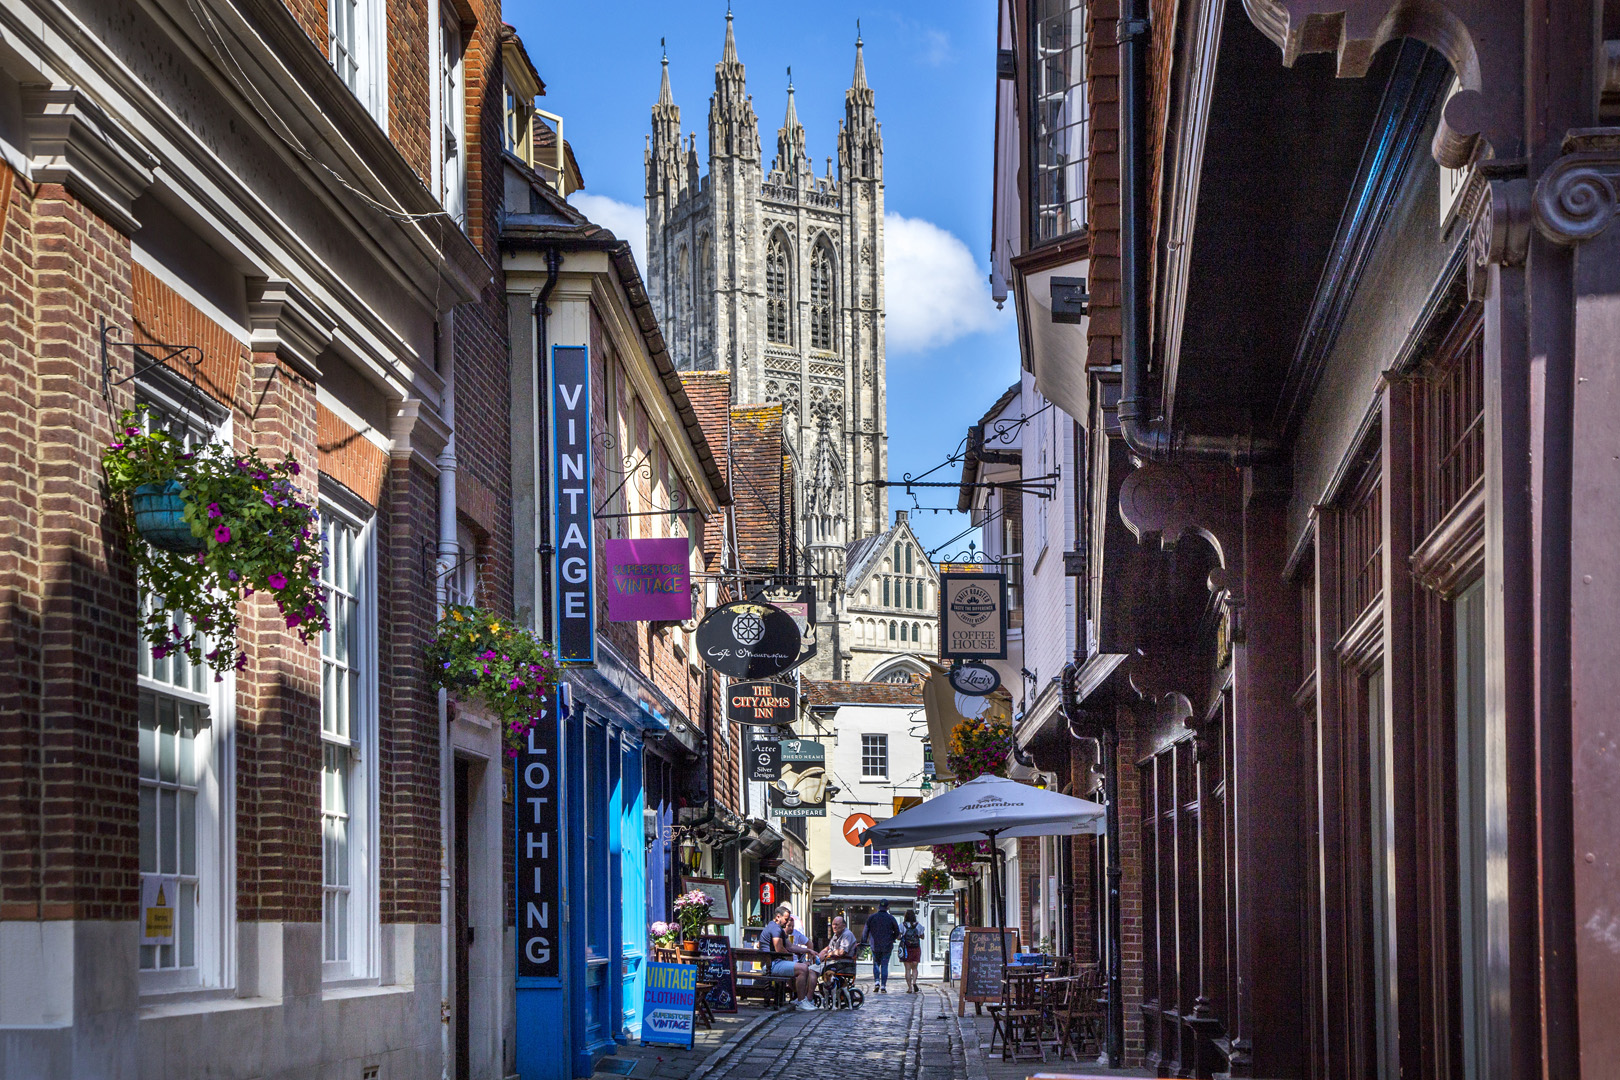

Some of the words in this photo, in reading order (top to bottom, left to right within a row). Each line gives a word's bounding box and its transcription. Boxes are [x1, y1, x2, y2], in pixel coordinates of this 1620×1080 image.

[558, 384, 587, 619] VINTAGE
[613, 564, 684, 576] SUPERSTORE
[614, 577, 683, 594] VINTAGE
[956, 590, 969, 603] DAILY
[970, 589, 990, 603] ROASTED
[952, 631, 995, 640] COFFEE
[953, 640, 996, 650] HOUSE
[752, 685, 773, 697] THE
[732, 696, 760, 708] CITY
[759, 696, 791, 708] ARMS
[754, 708, 774, 719] INN
[752, 744, 776, 752] Aztec
[959, 800, 1025, 812] Alhambra
[646, 966, 696, 991] VINTAGE
[644, 990, 694, 1006] CLOTHING
[652, 1011, 692, 1020] SUPERSTORE
[652, 1019, 690, 1030] VINTAGE
